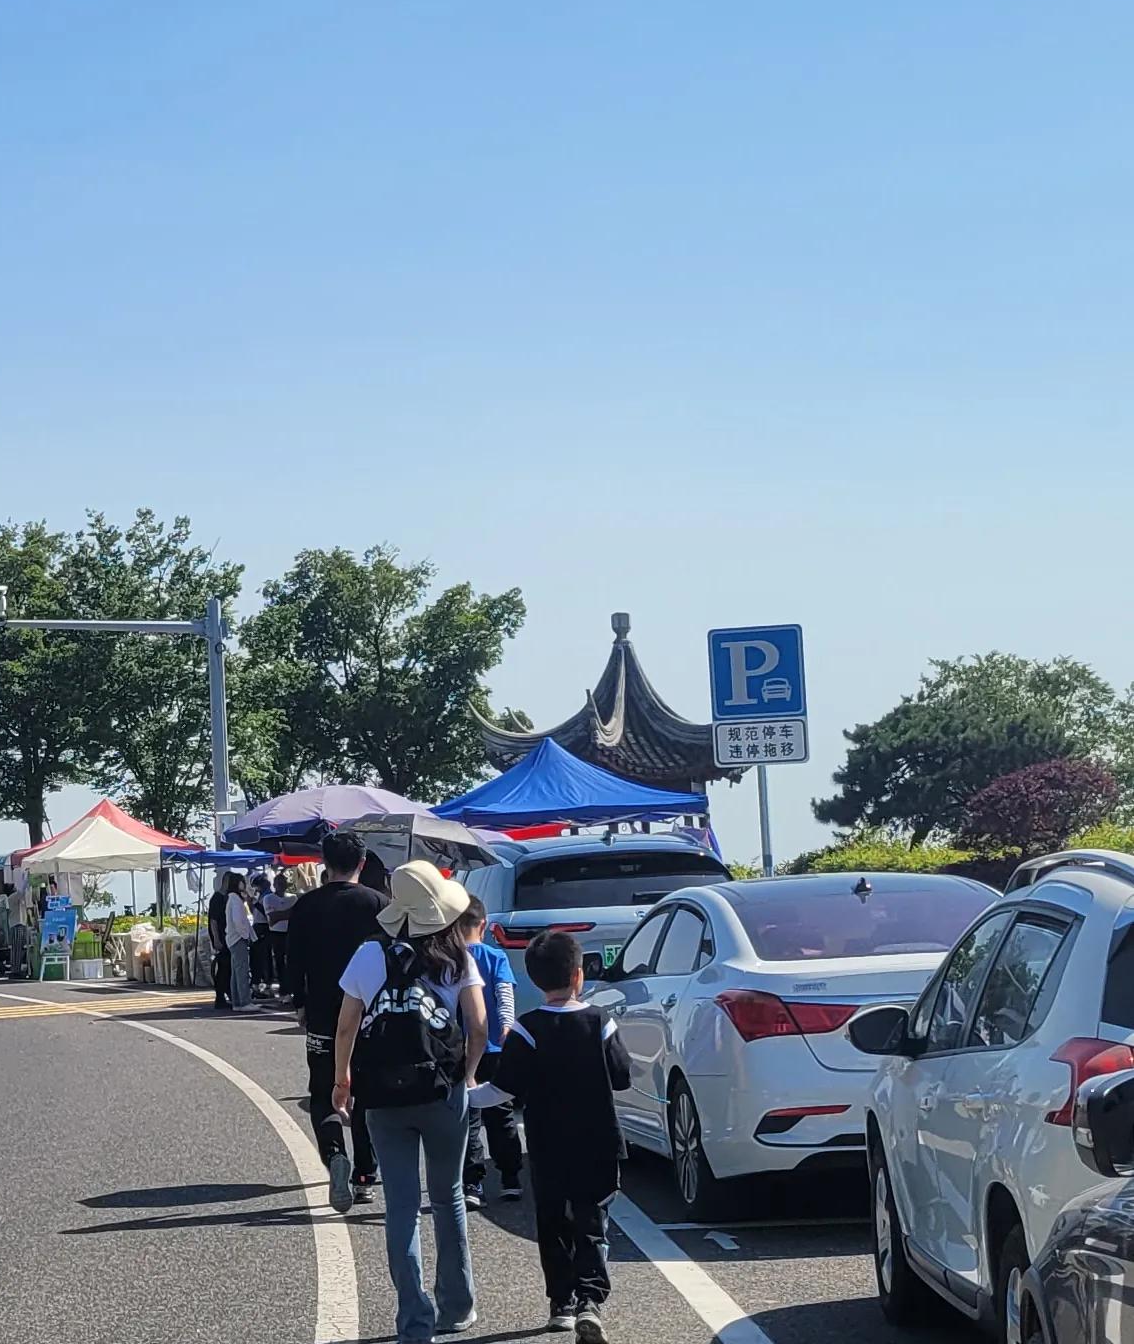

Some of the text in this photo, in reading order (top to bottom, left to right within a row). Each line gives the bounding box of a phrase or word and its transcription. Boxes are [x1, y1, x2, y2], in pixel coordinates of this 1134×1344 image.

[720, 640, 780, 706] P
[727, 724, 795, 741] 规范停车
[729, 742, 795, 759] 违停拖移
